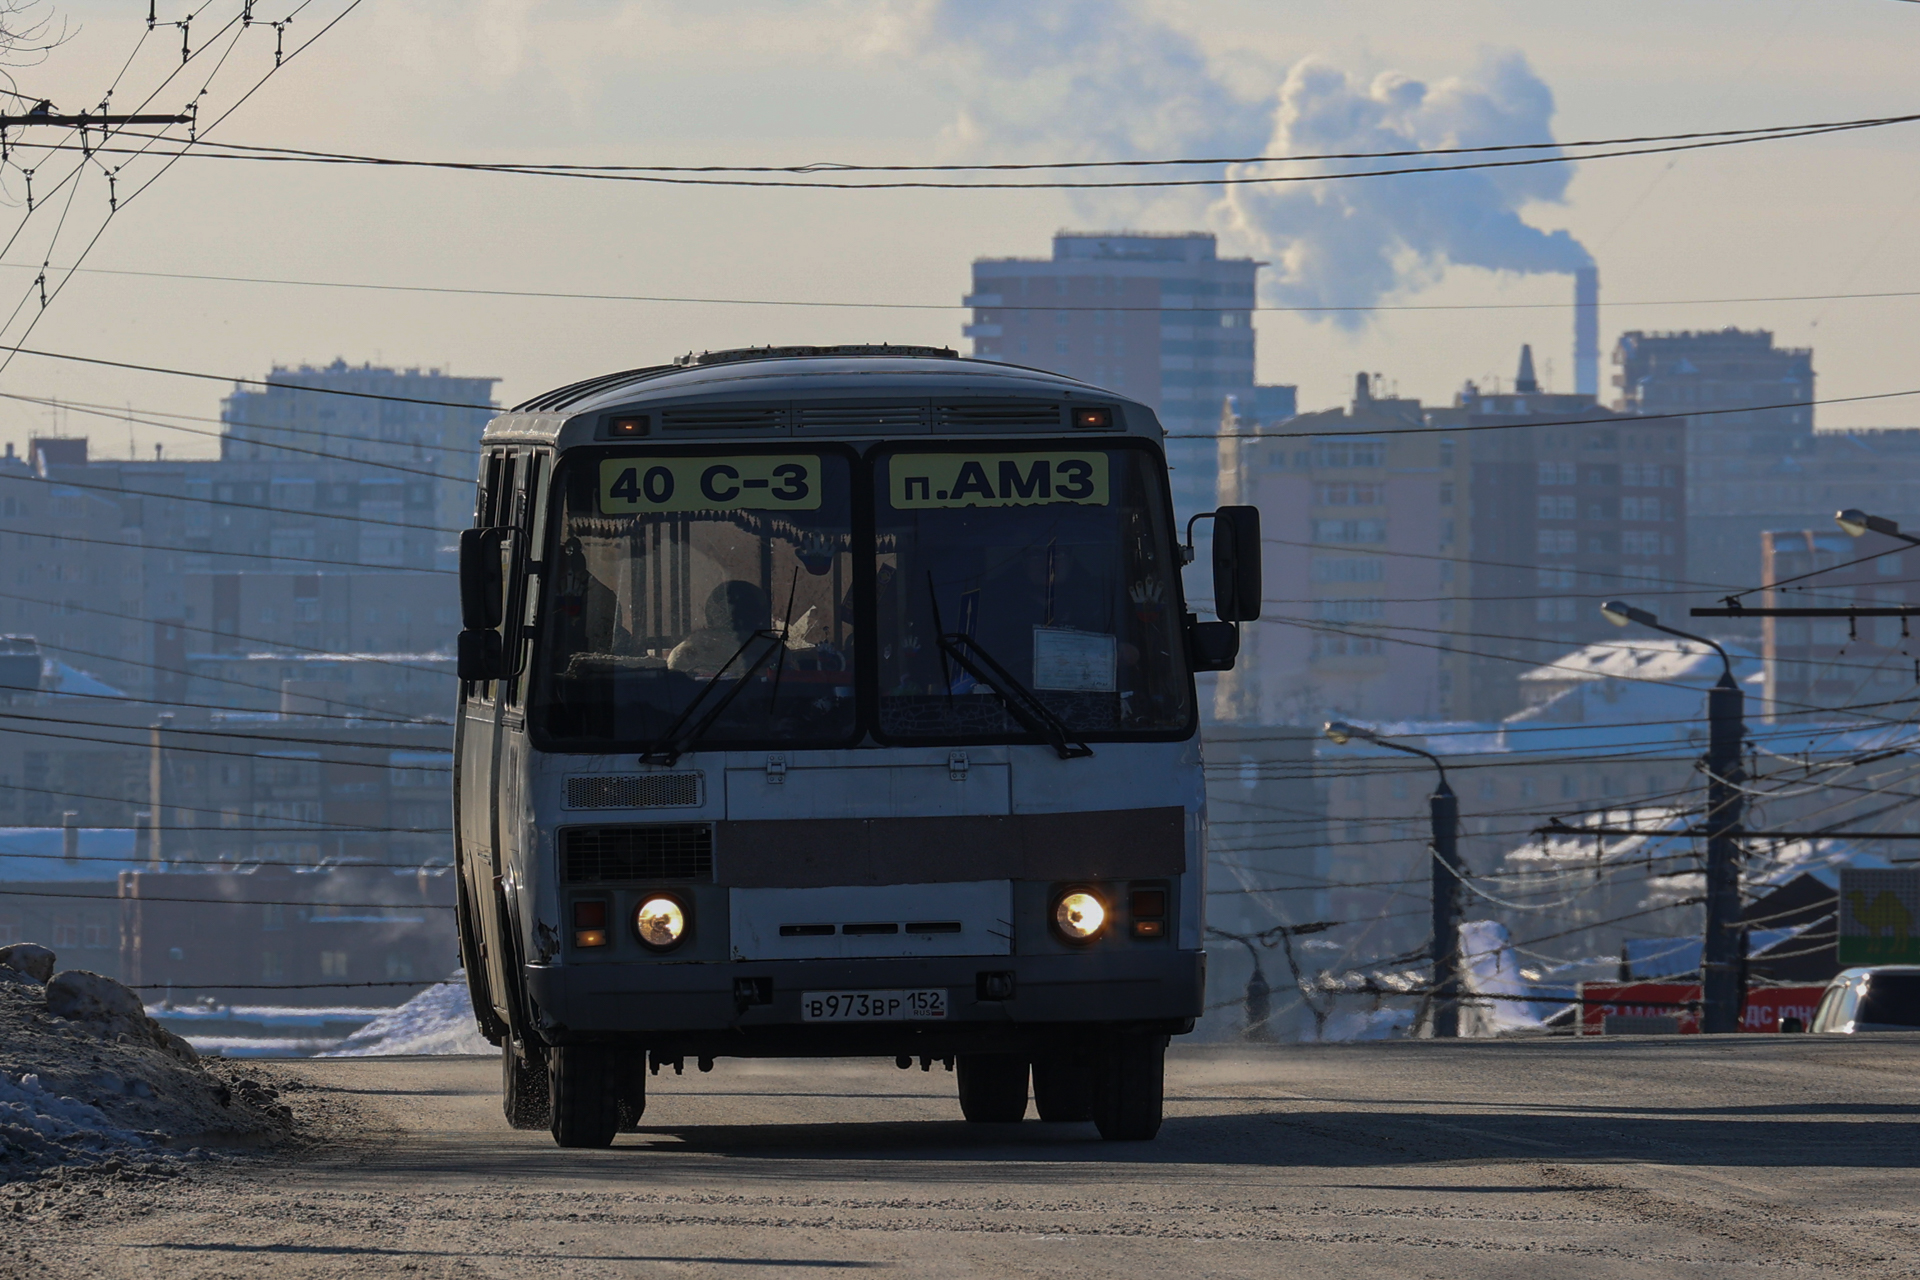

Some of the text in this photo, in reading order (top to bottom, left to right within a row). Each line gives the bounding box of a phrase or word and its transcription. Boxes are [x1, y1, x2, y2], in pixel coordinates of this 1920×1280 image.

[609, 466, 675, 503] 40
[811, 992, 940, 1017] В973ВР 152
